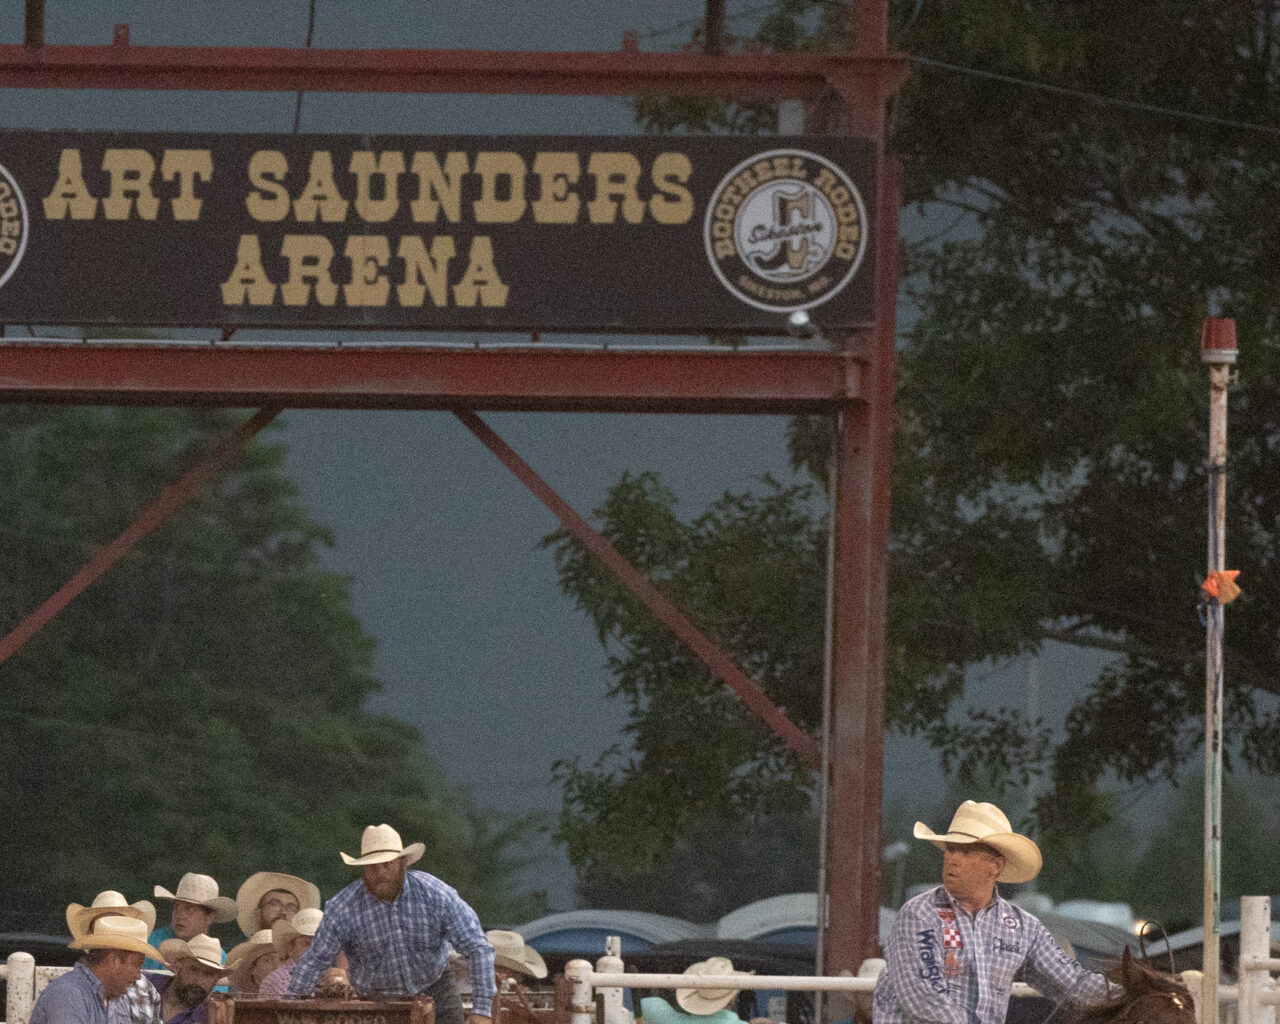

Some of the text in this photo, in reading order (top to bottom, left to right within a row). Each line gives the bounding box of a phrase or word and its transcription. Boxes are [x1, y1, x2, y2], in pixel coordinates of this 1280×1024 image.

[42, 147, 695, 225] ART SAUNDERS
[220, 233, 510, 307] ARENA
